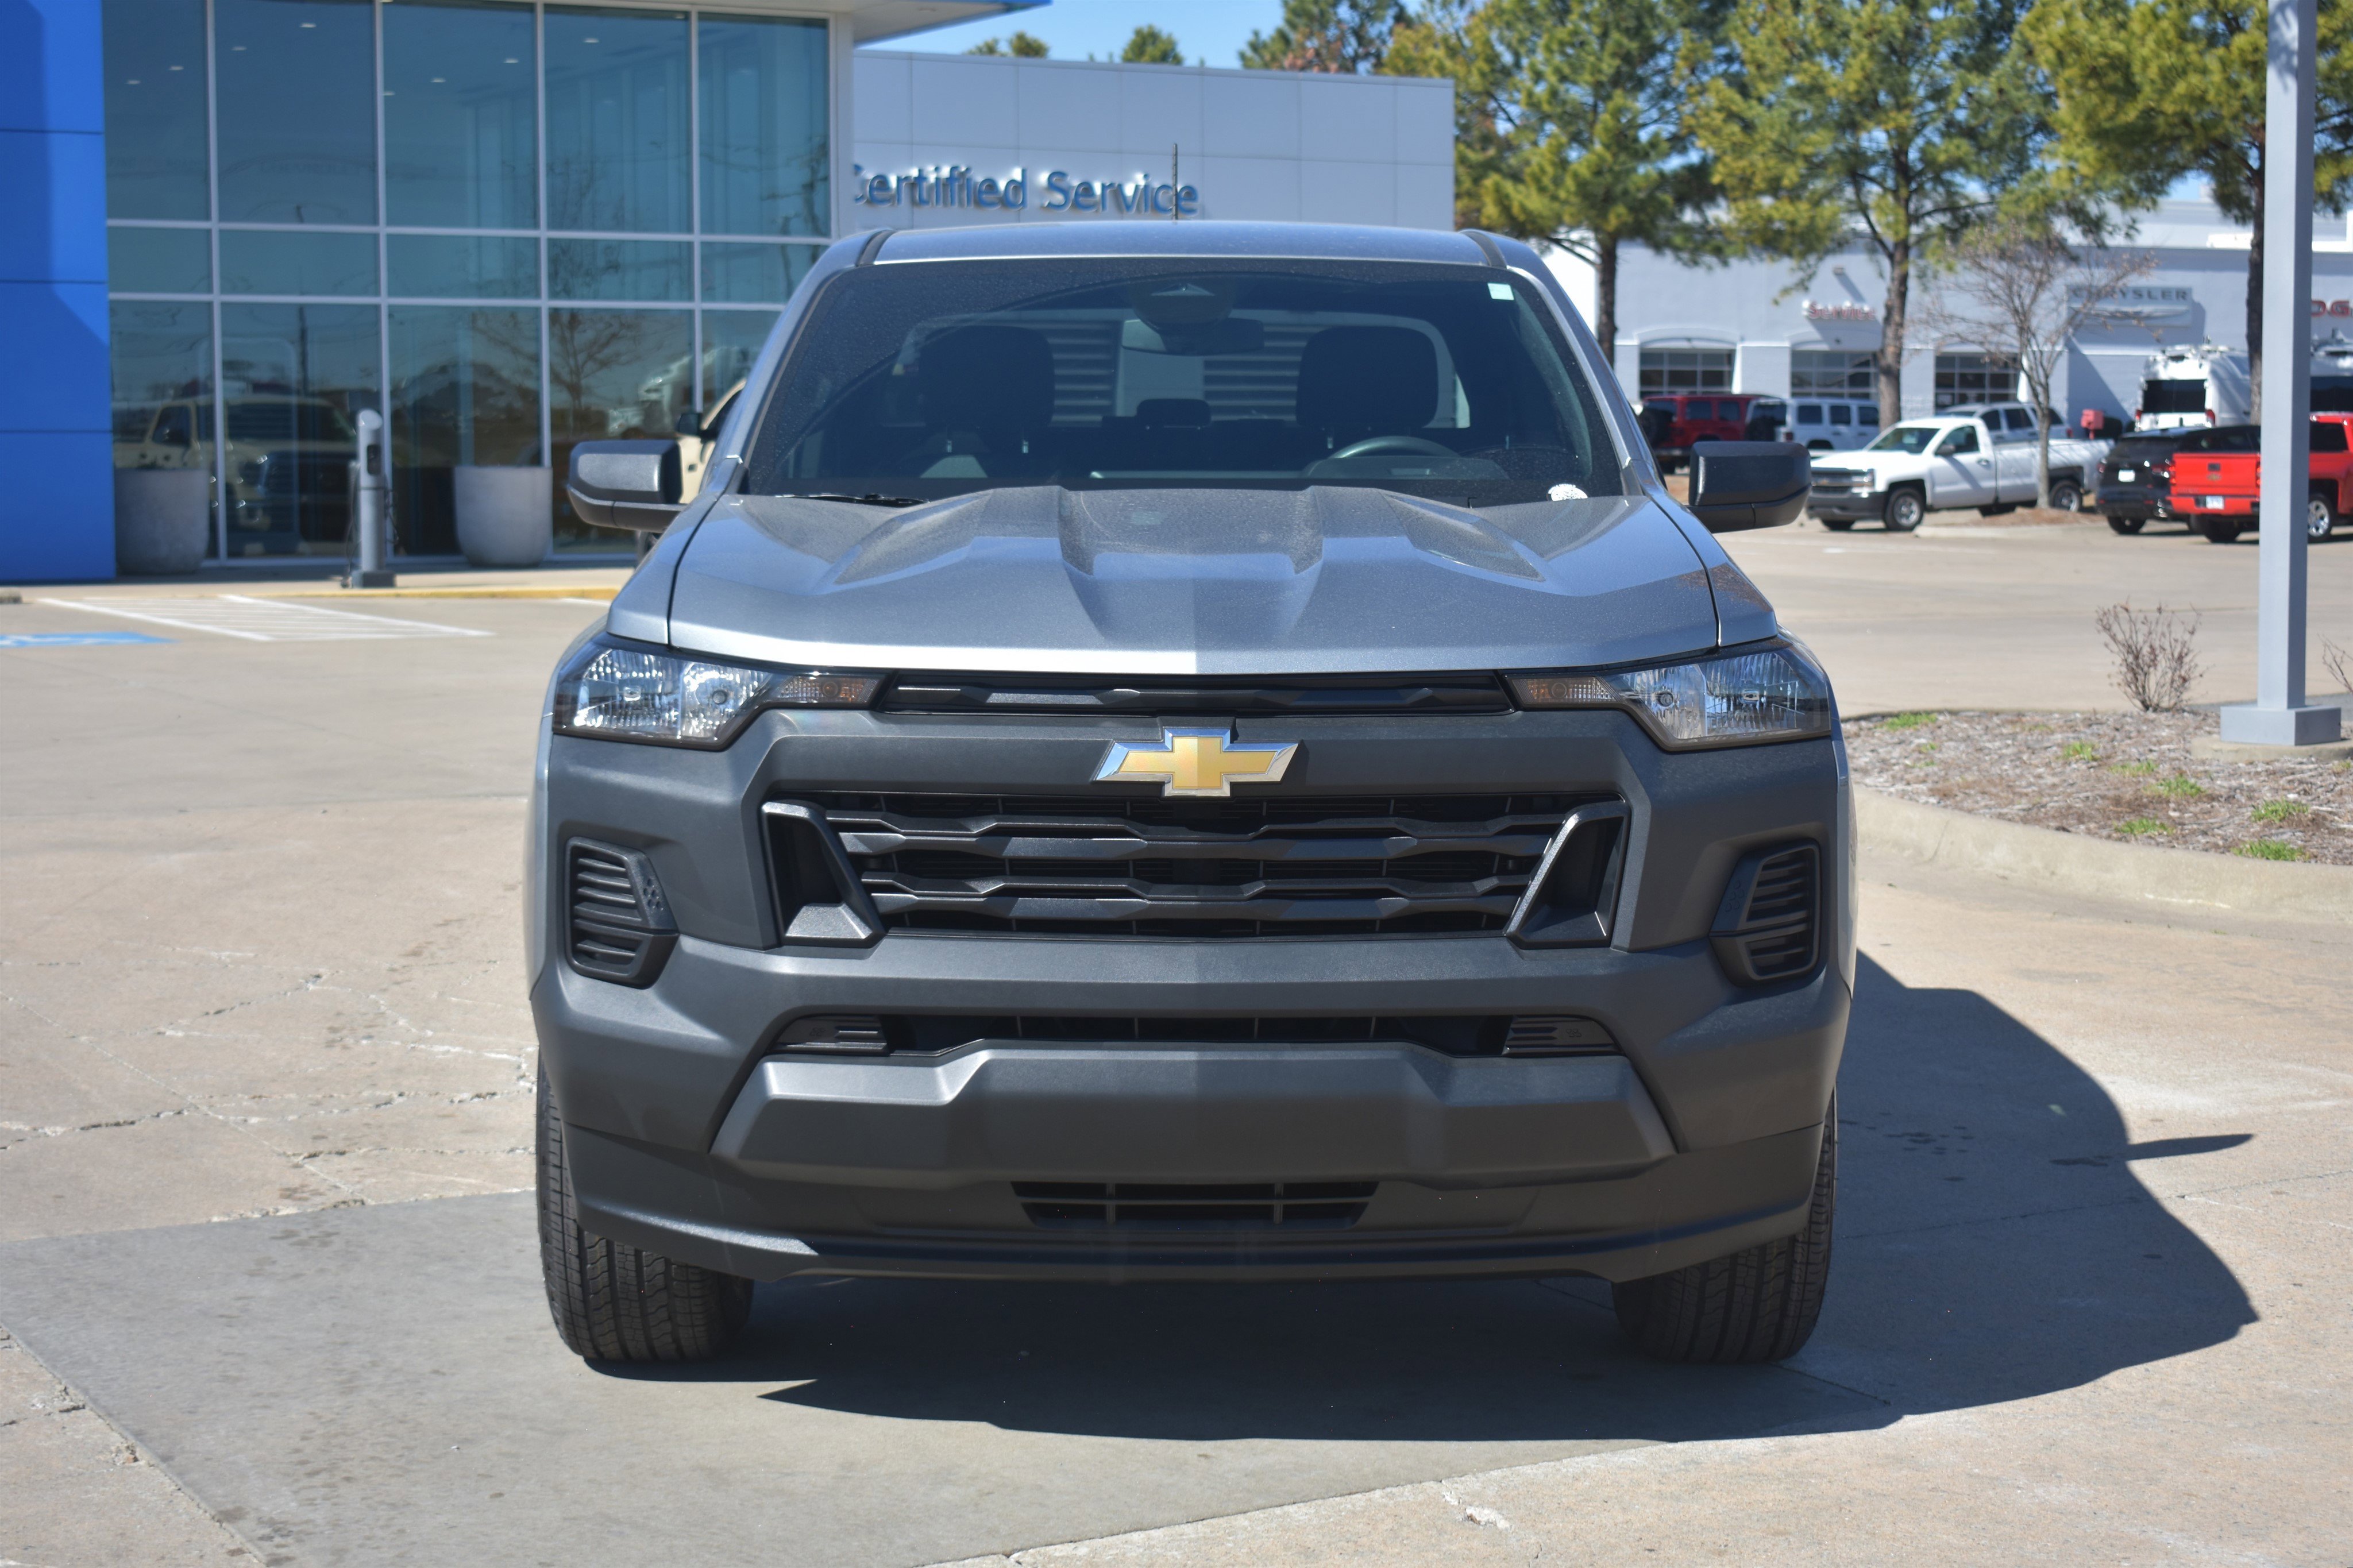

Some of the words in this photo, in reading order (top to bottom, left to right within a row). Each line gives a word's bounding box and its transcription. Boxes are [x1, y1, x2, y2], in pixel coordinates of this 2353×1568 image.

[1046, 171, 1198, 216] Service
[2072, 288, 2188, 301] CYSLER
[1808, 302, 1876, 320] Service
